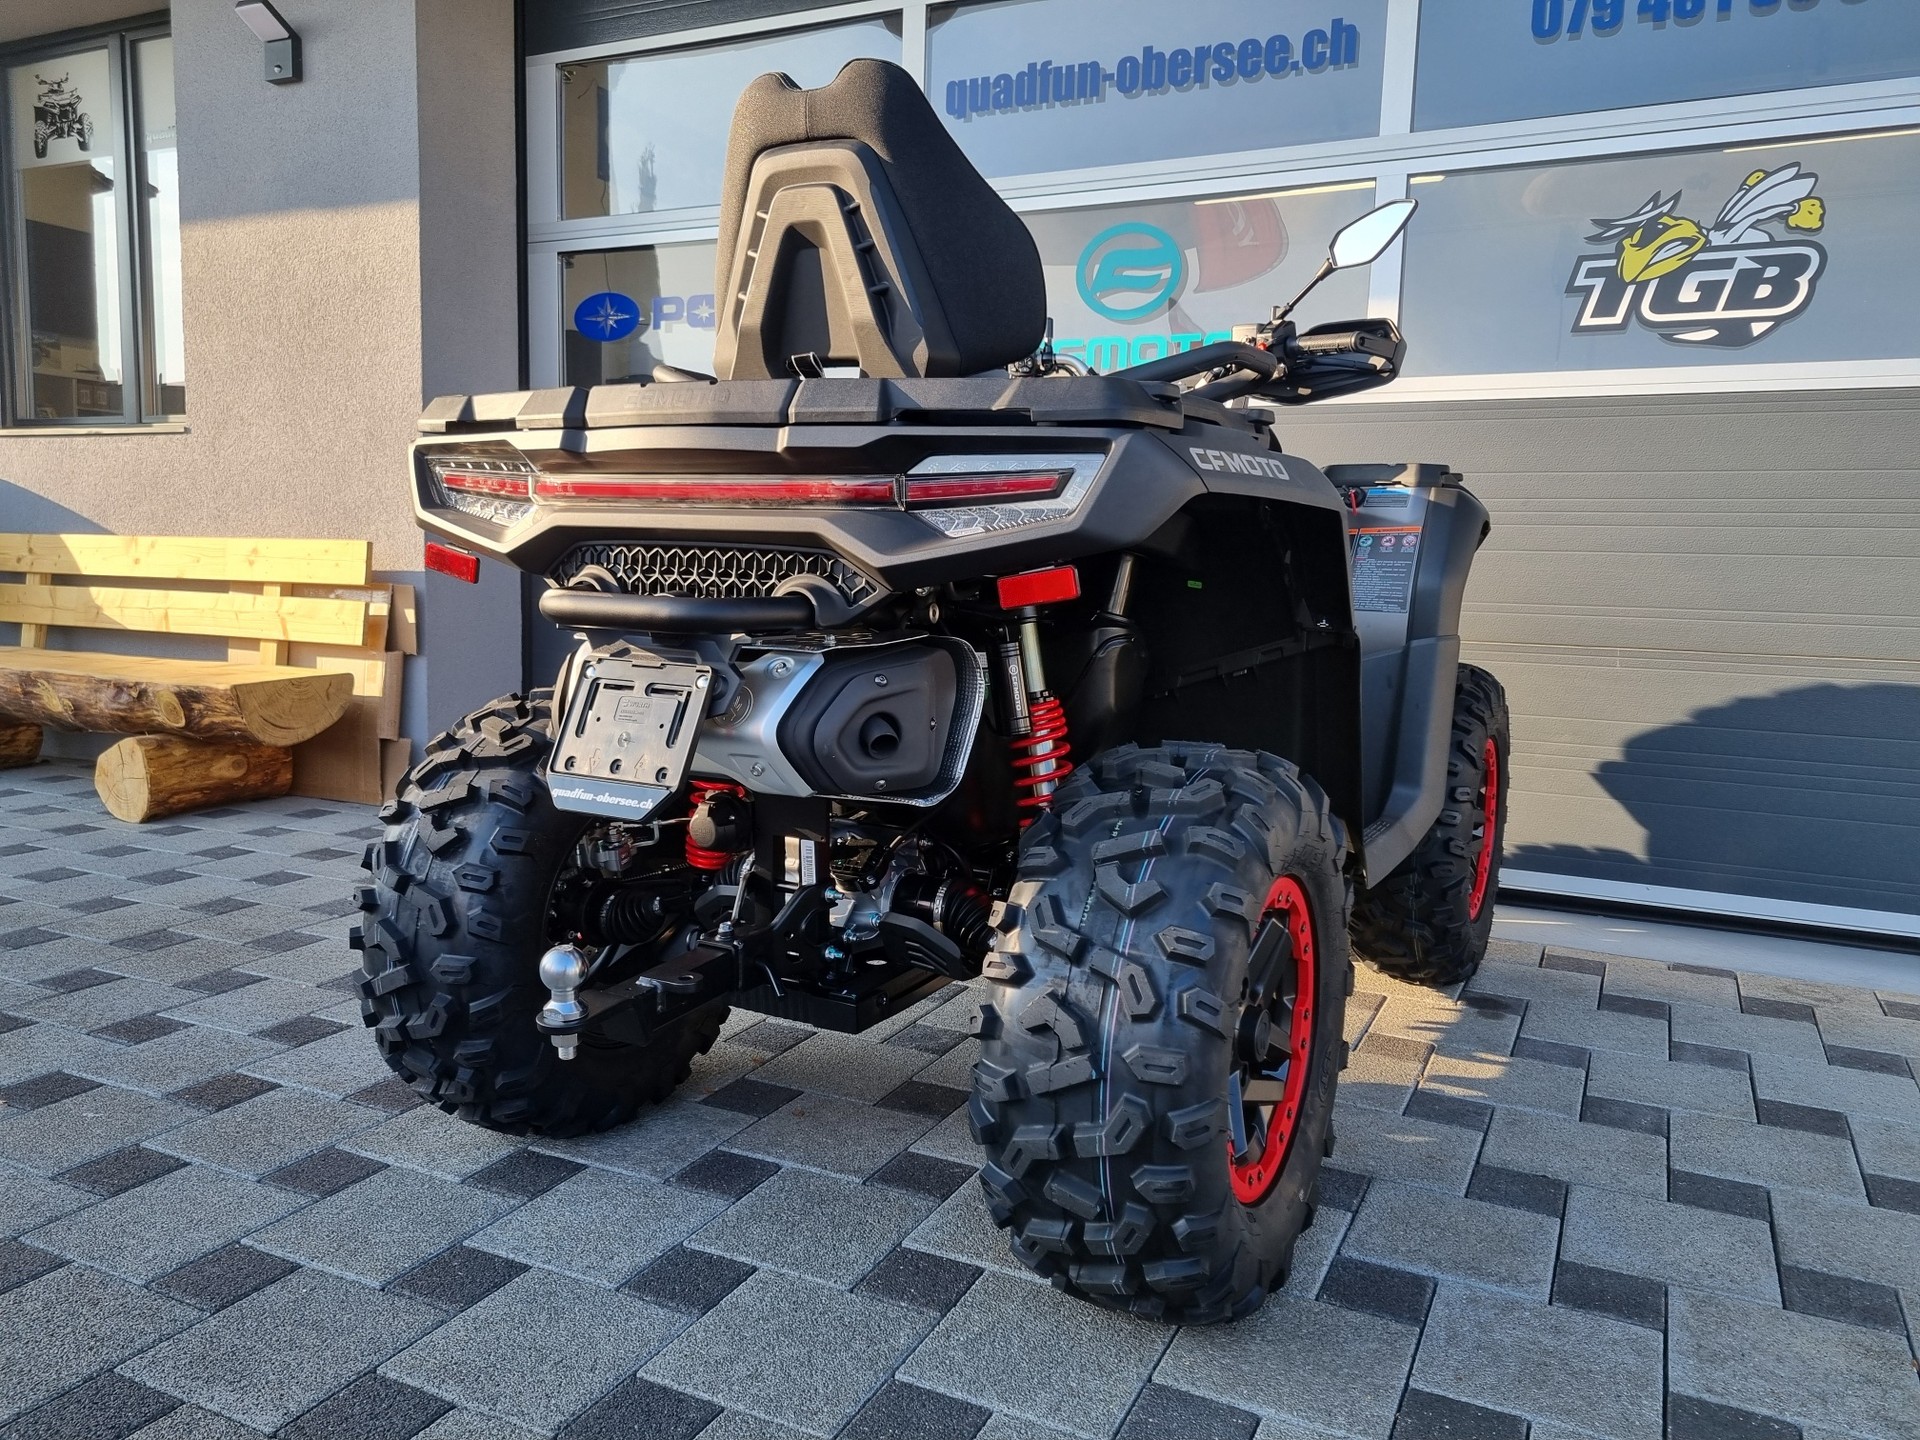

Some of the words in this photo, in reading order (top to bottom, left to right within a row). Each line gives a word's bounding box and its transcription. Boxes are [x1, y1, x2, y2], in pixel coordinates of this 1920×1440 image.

[946, 17, 1358, 120] quadfun-obersee.ch
[1566, 241, 1826, 331] TGB
[1189, 447, 1290, 480] CFMOTO
[1012, 675, 1022, 711] CFMOTO
[551, 788, 653, 810] quadfun-obersee.ch
